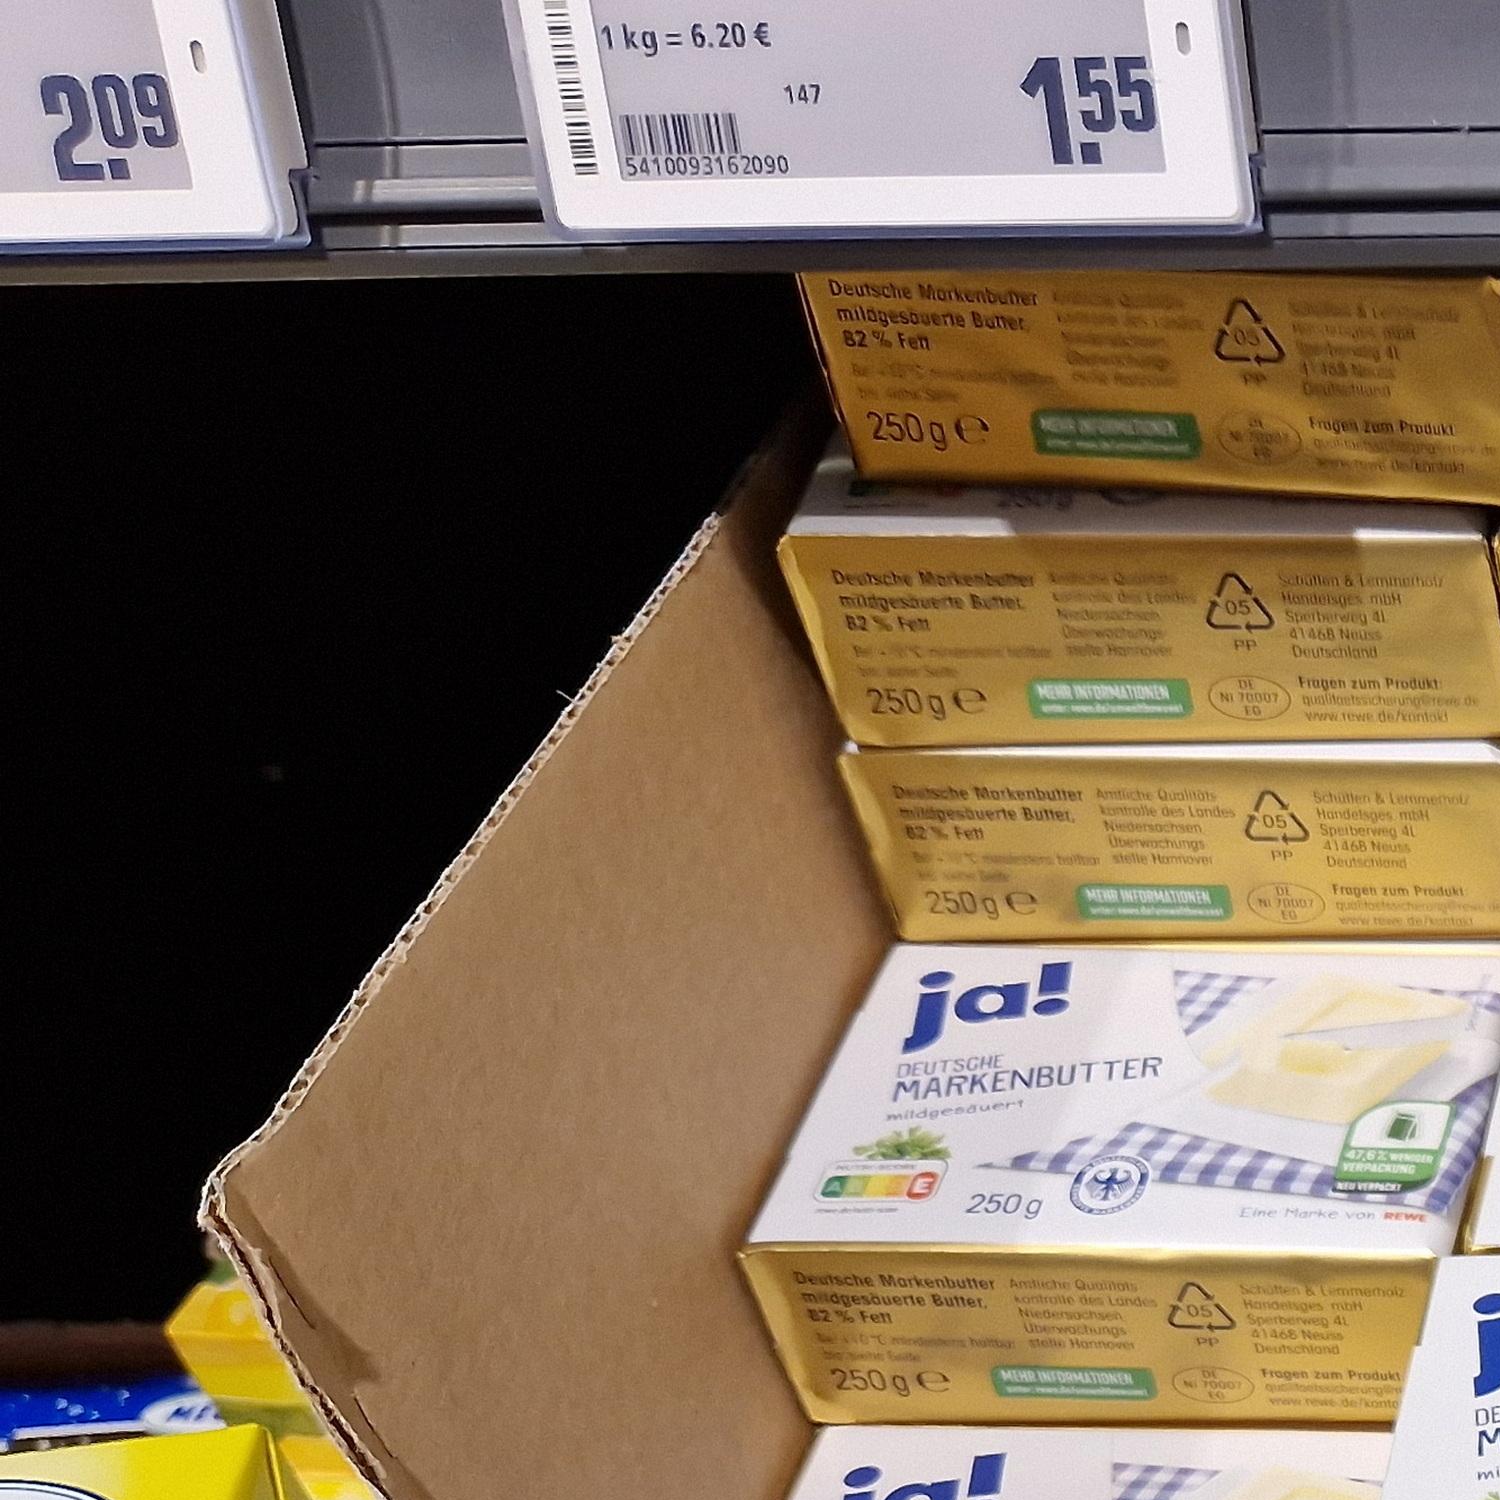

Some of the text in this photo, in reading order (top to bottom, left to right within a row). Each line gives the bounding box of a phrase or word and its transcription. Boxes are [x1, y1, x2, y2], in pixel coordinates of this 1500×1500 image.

[602, 22, 771, 58] 1 kg = 6.20 €
[783, 84, 821, 105] 147
[1021, 58, 1156, 164] 1.55
[40, 73, 179, 181] 2.09
[625, 155, 789, 176] 5410093162090
[901, 961, 1074, 1054] ja!
[892, 1056, 1164, 1101] MARKENBUTTER
